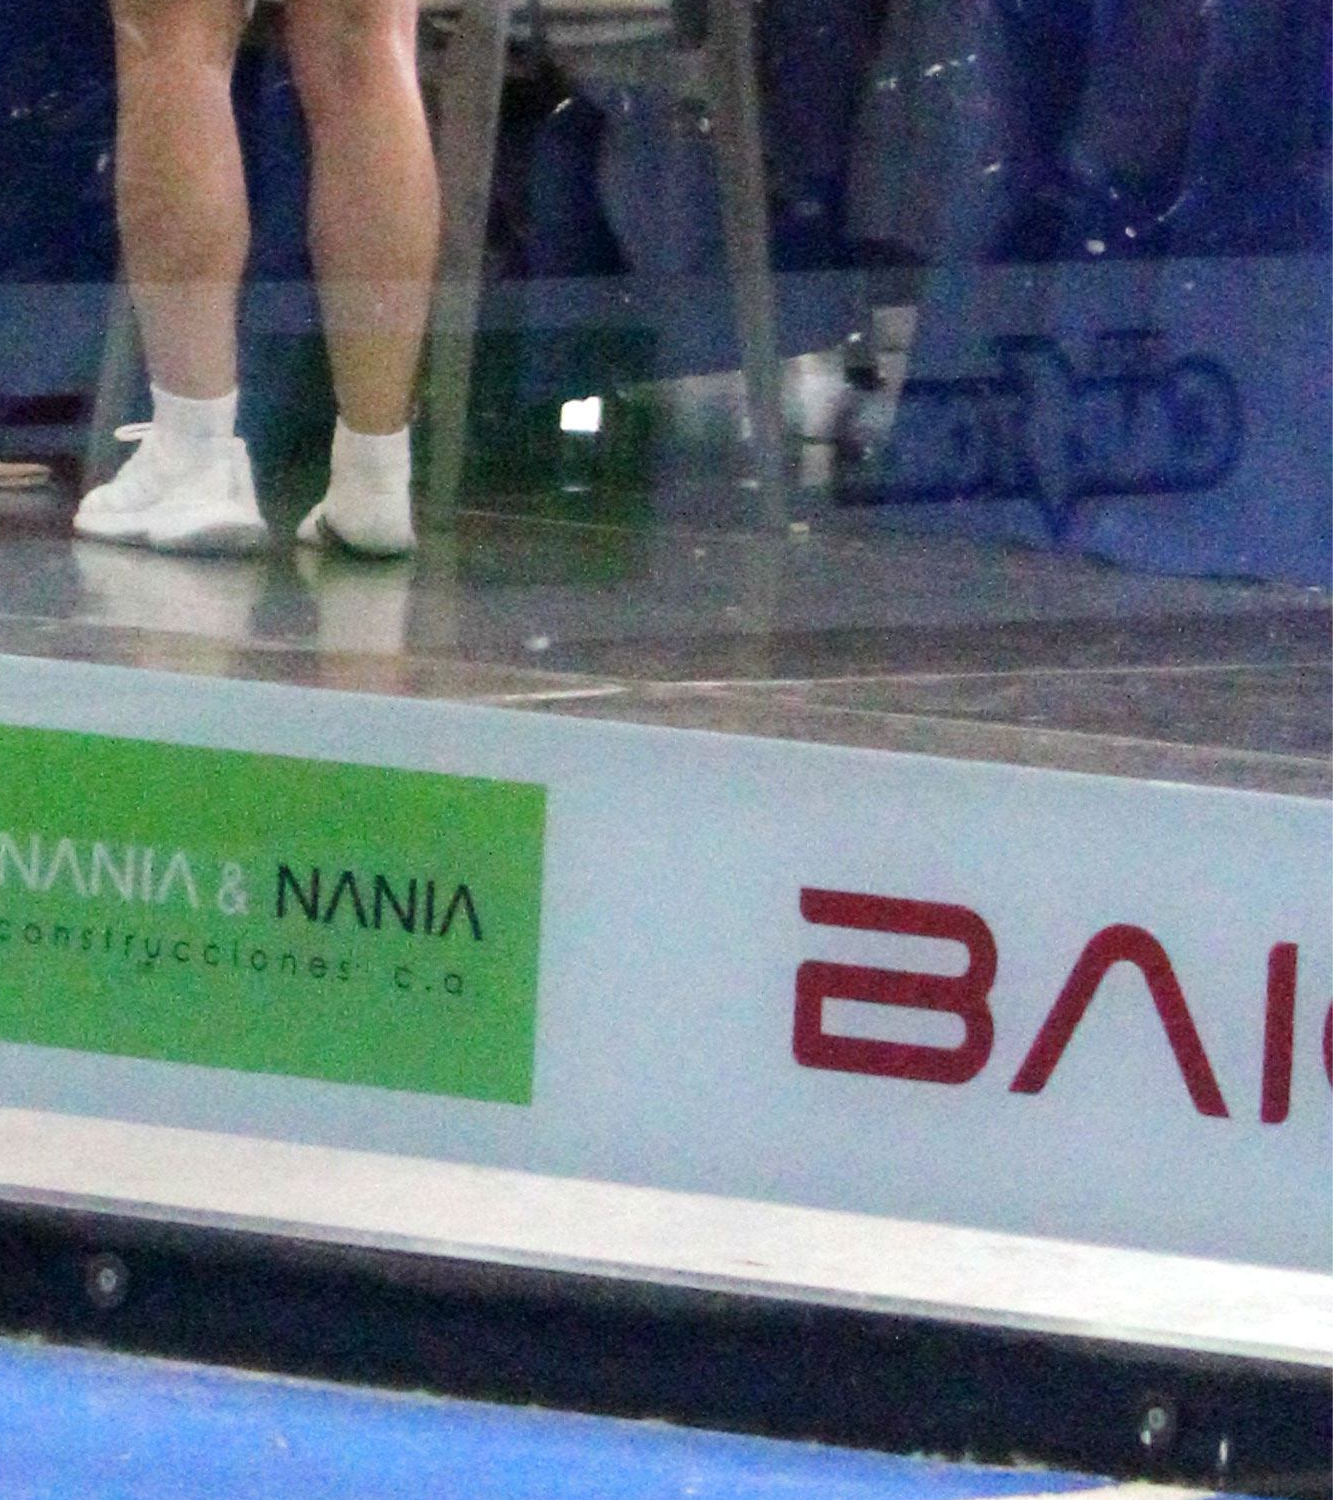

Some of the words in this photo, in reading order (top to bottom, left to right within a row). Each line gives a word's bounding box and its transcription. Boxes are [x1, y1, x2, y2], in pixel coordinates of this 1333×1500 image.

[217, 860, 248, 915] &
[276, 863, 483, 942] NANIA
[792, 886, 1333, 1124] BAI
